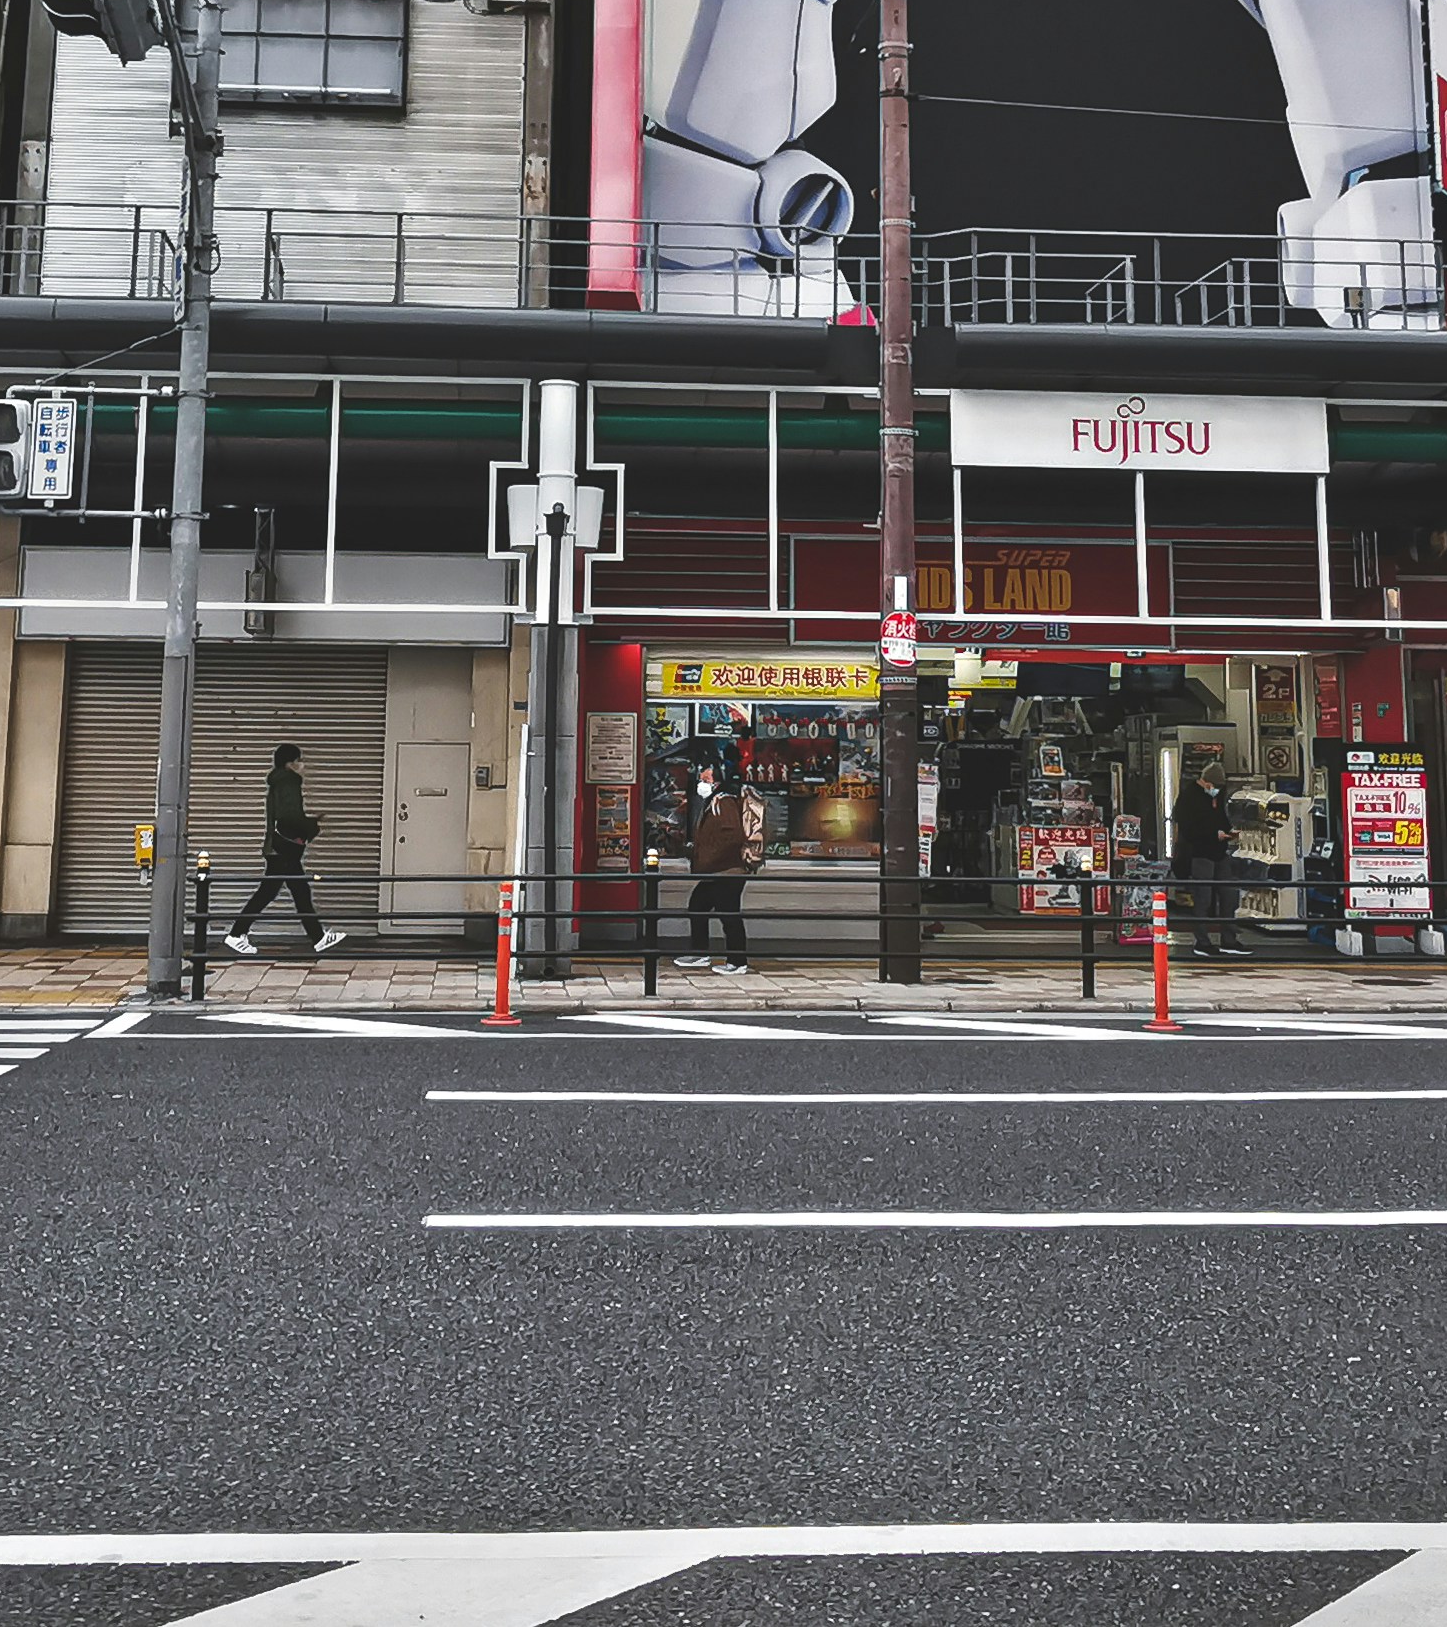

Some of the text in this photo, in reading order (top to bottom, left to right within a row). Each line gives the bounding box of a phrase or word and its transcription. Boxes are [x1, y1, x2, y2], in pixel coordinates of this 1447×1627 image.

[38, 406, 53, 454] 自転車
[54, 406, 70, 454] 歩行者
[1071, 417, 1212, 466] FUJITSU
[995, 549, 1072, 567] SUPER
[983, 567, 1072, 611] LAND
[710, 665, 870, 689] 欢迎使用银联卡
[1351, 772, 1421, 788] TAX-FREE
